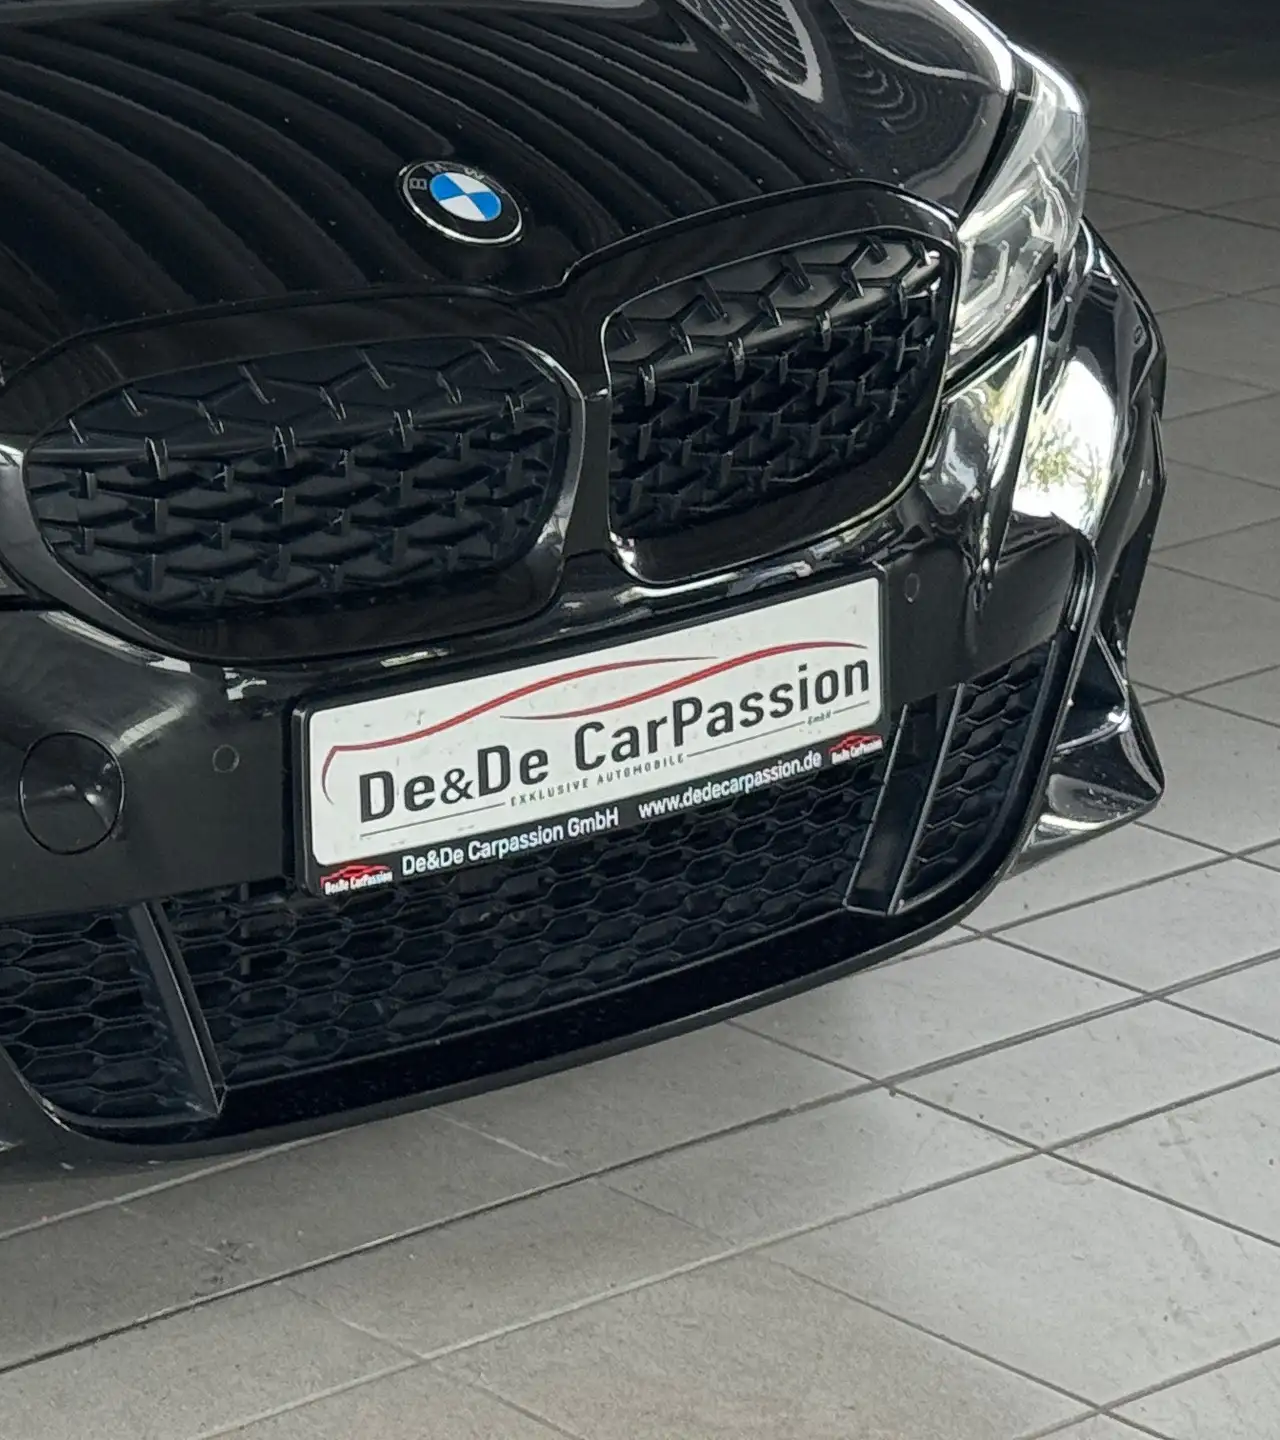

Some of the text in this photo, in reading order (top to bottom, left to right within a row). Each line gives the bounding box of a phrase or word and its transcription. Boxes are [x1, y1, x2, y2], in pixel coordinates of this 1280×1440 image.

[360, 658, 870, 823] De&De CarPassion
[510, 753, 684, 807] EXKLUSIVE AUTOMOBILE
[401, 748, 823, 877] De&De Carpassion GmbH www.dedecarpassion.de
